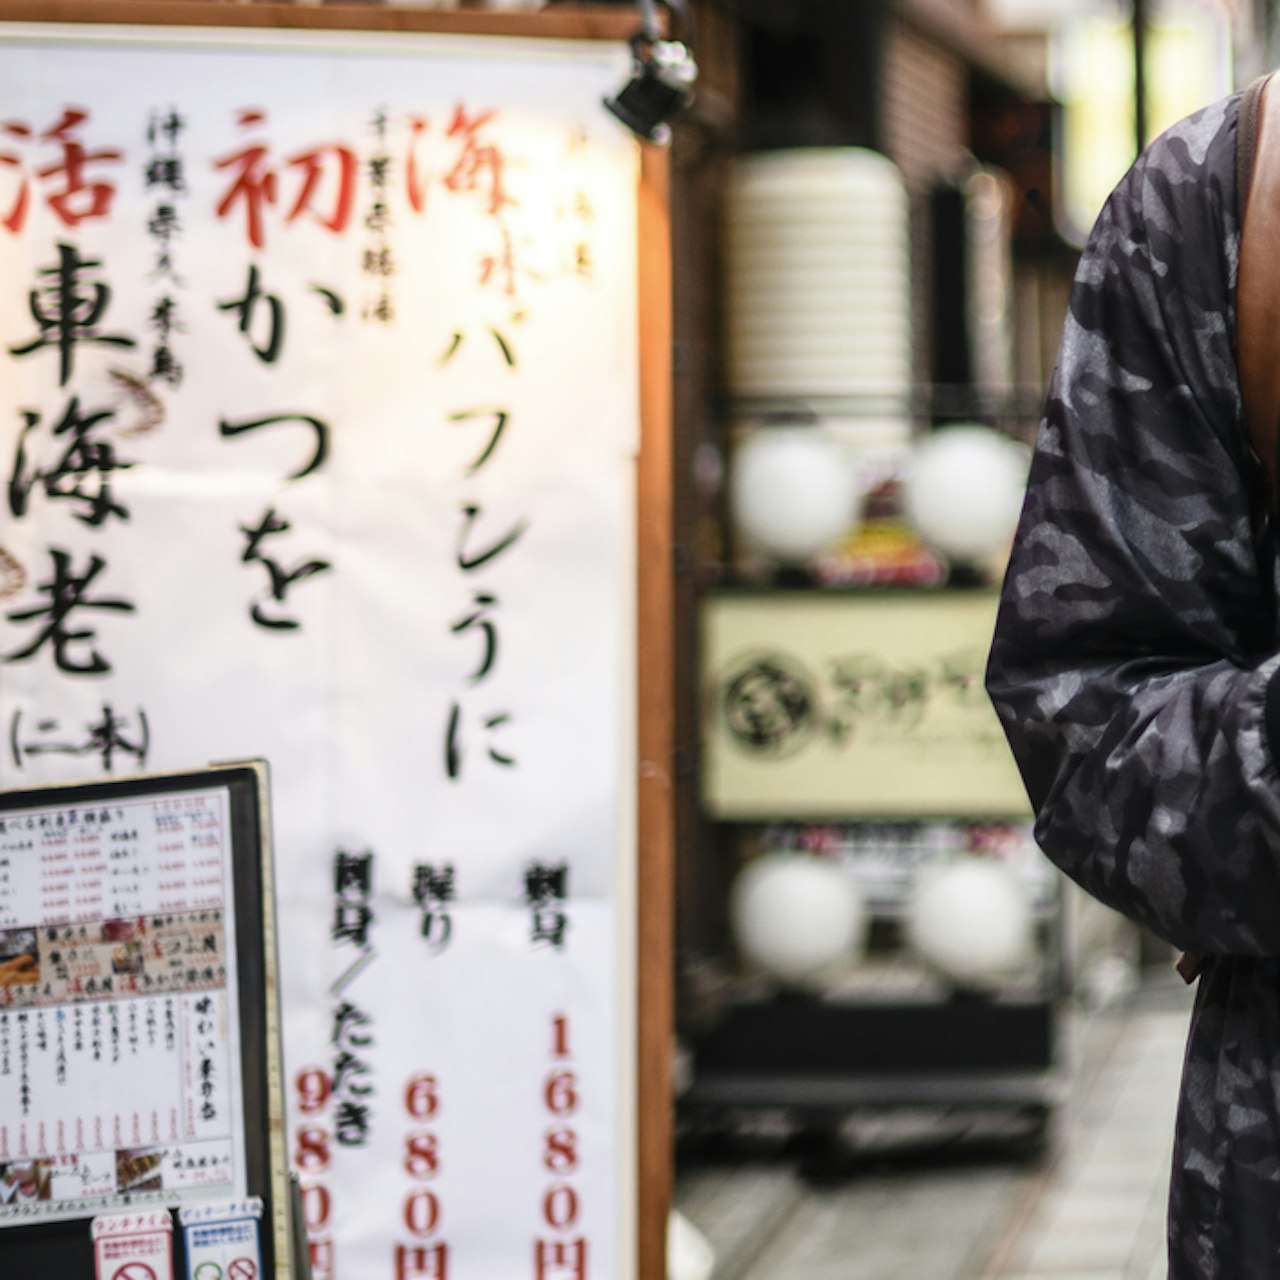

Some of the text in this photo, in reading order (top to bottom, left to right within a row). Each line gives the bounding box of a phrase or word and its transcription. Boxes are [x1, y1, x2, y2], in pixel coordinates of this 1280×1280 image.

[144, 106, 187, 389] 沖縄県久米島
[210, 107, 358, 632] 初かつを
[0, 104, 136, 675] 活車海老
[394, 1073, 449, 1280] 680円
[533, 1012, 588, 1280] 1680円
